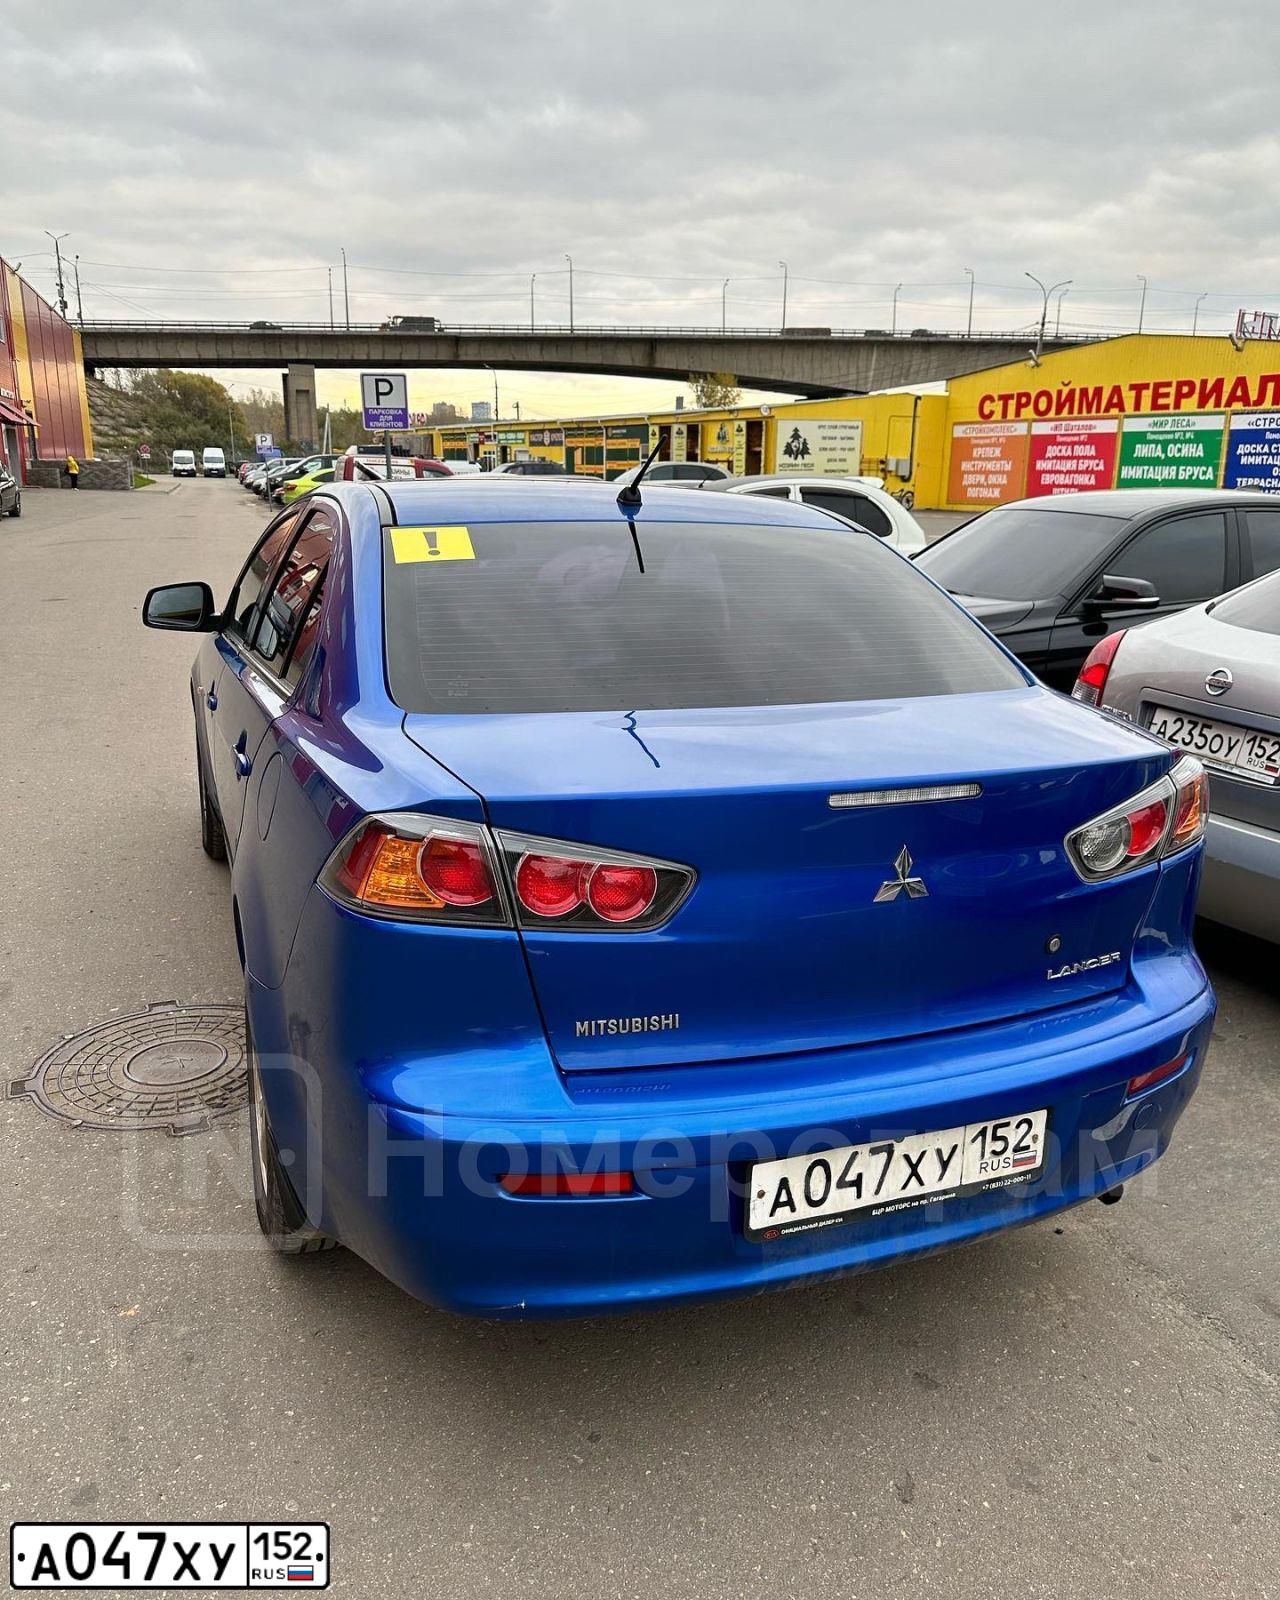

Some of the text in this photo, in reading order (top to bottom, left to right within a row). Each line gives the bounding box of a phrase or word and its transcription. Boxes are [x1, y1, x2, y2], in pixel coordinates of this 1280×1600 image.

[375, 378, 394, 406] P
[977, 374, 1280, 420] СТРОЙМАТЕРИАЛ
[1148, 418, 1196, 429] «МИР ЛЕСА»
[1045, 444, 1096, 458] ДОСКА ПОЛА
[1133, 443, 1204, 459] ЛИПА, ОСИНА
[1236, 443, 1269, 455] ДОСКА
[961, 460, 1012, 471] ИНСТРУМЕНТЫ
[1035, 459, 1105, 472] ИМИТАЦИЯ БРУСА
[1120, 465, 1214, 482] ИМИТАЦИЯ БРУСА
[1040, 473, 1096, 485] ЕВРОВАГОНКА
[1156, 717, 1240, 757] А235ОУ
[1246, 734, 1280, 763] 152
[1246, 757, 1266, 769] RUS
[1047, 951, 1121, 980] LANCER
[575, 1013, 680, 1037] MITSUBISHI
[970, 1117, 1034, 1159] 152
[979, 1157, 1011, 1175] RUS
[769, 1142, 959, 1218] А047ХУ
[885, 1202, 911, 1213] МОТОРС
[929, 1192, 957, 1203] Гагарина
